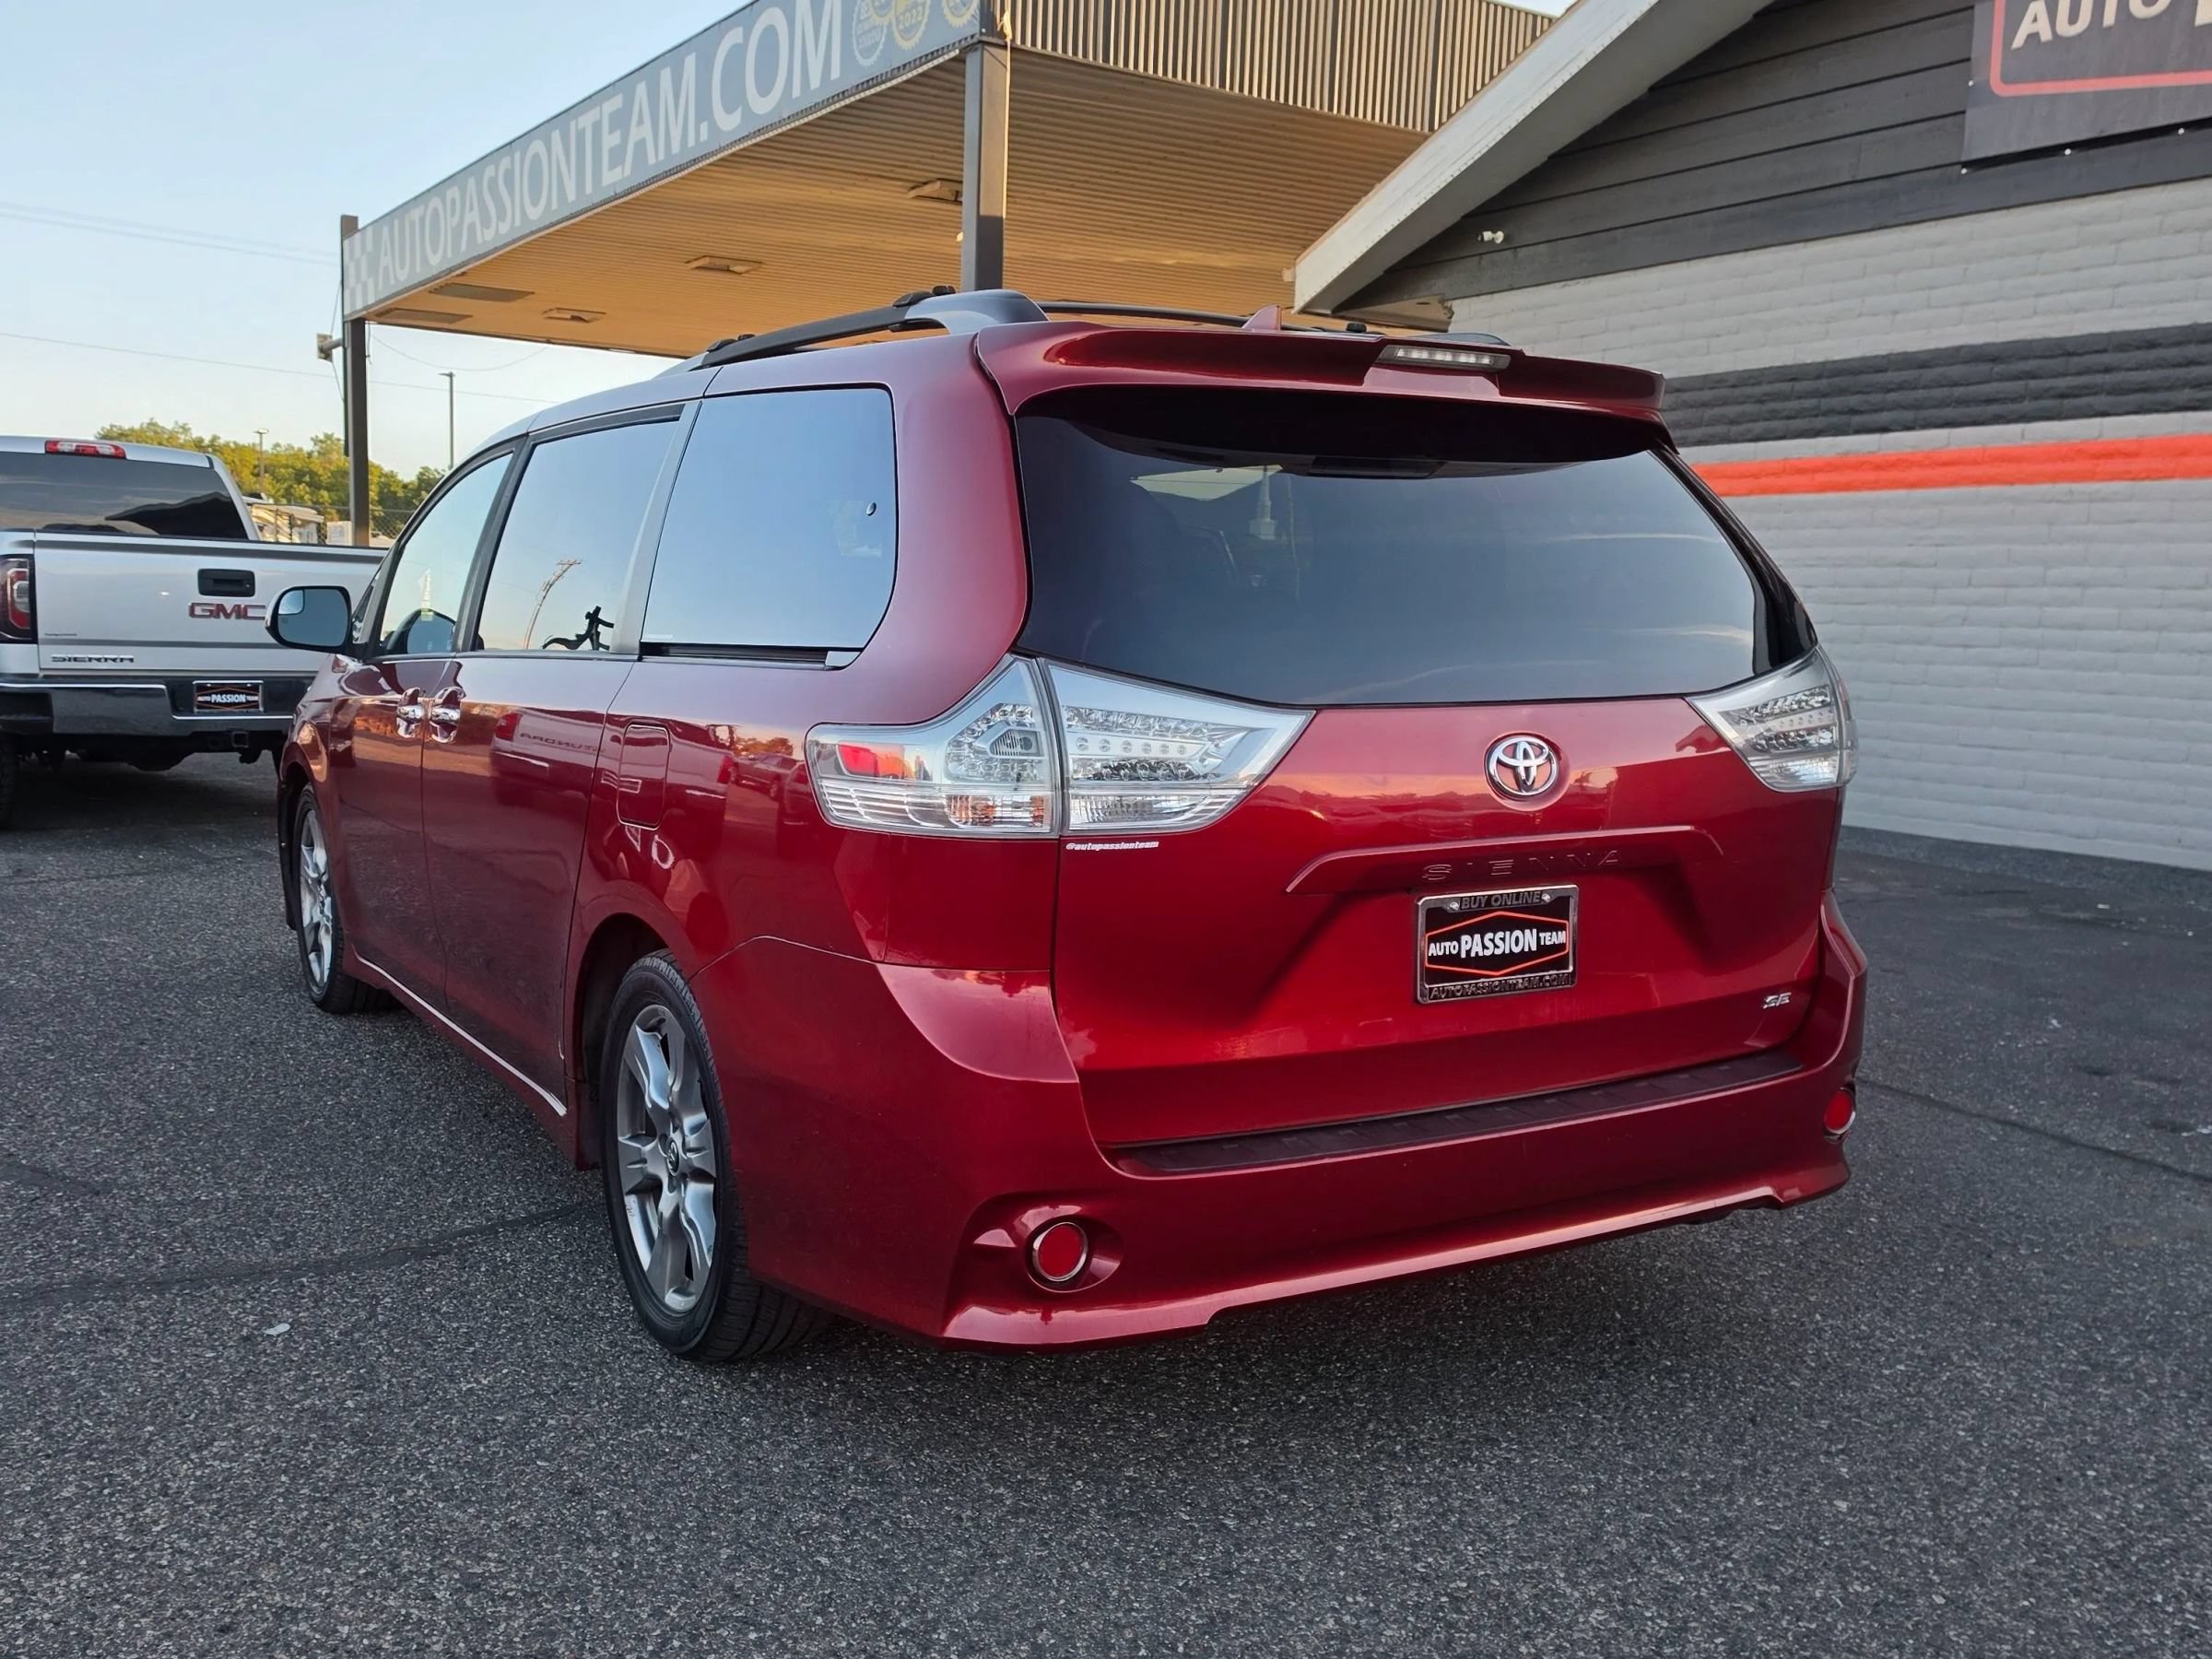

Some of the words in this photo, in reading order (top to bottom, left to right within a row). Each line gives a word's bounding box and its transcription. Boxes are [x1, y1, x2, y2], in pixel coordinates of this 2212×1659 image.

[377, 0, 841, 290] AUTOPASSIONTEAM.COM
[188, 602, 266, 621] GMC
[51, 653, 135, 664] SIERRA
[211, 694, 246, 703] PASSION
[1461, 895, 1488, 910] BUY
[1491, 891, 1542, 907] ONLINE
[1429, 941, 1458, 956] AUTO
[1461, 928, 1537, 959] PASSION
[1539, 930, 1567, 946] TEAM
[1430, 974, 1568, 999] AUTOPASSIONTEAM.COM
[1762, 992, 1793, 1009] SE
